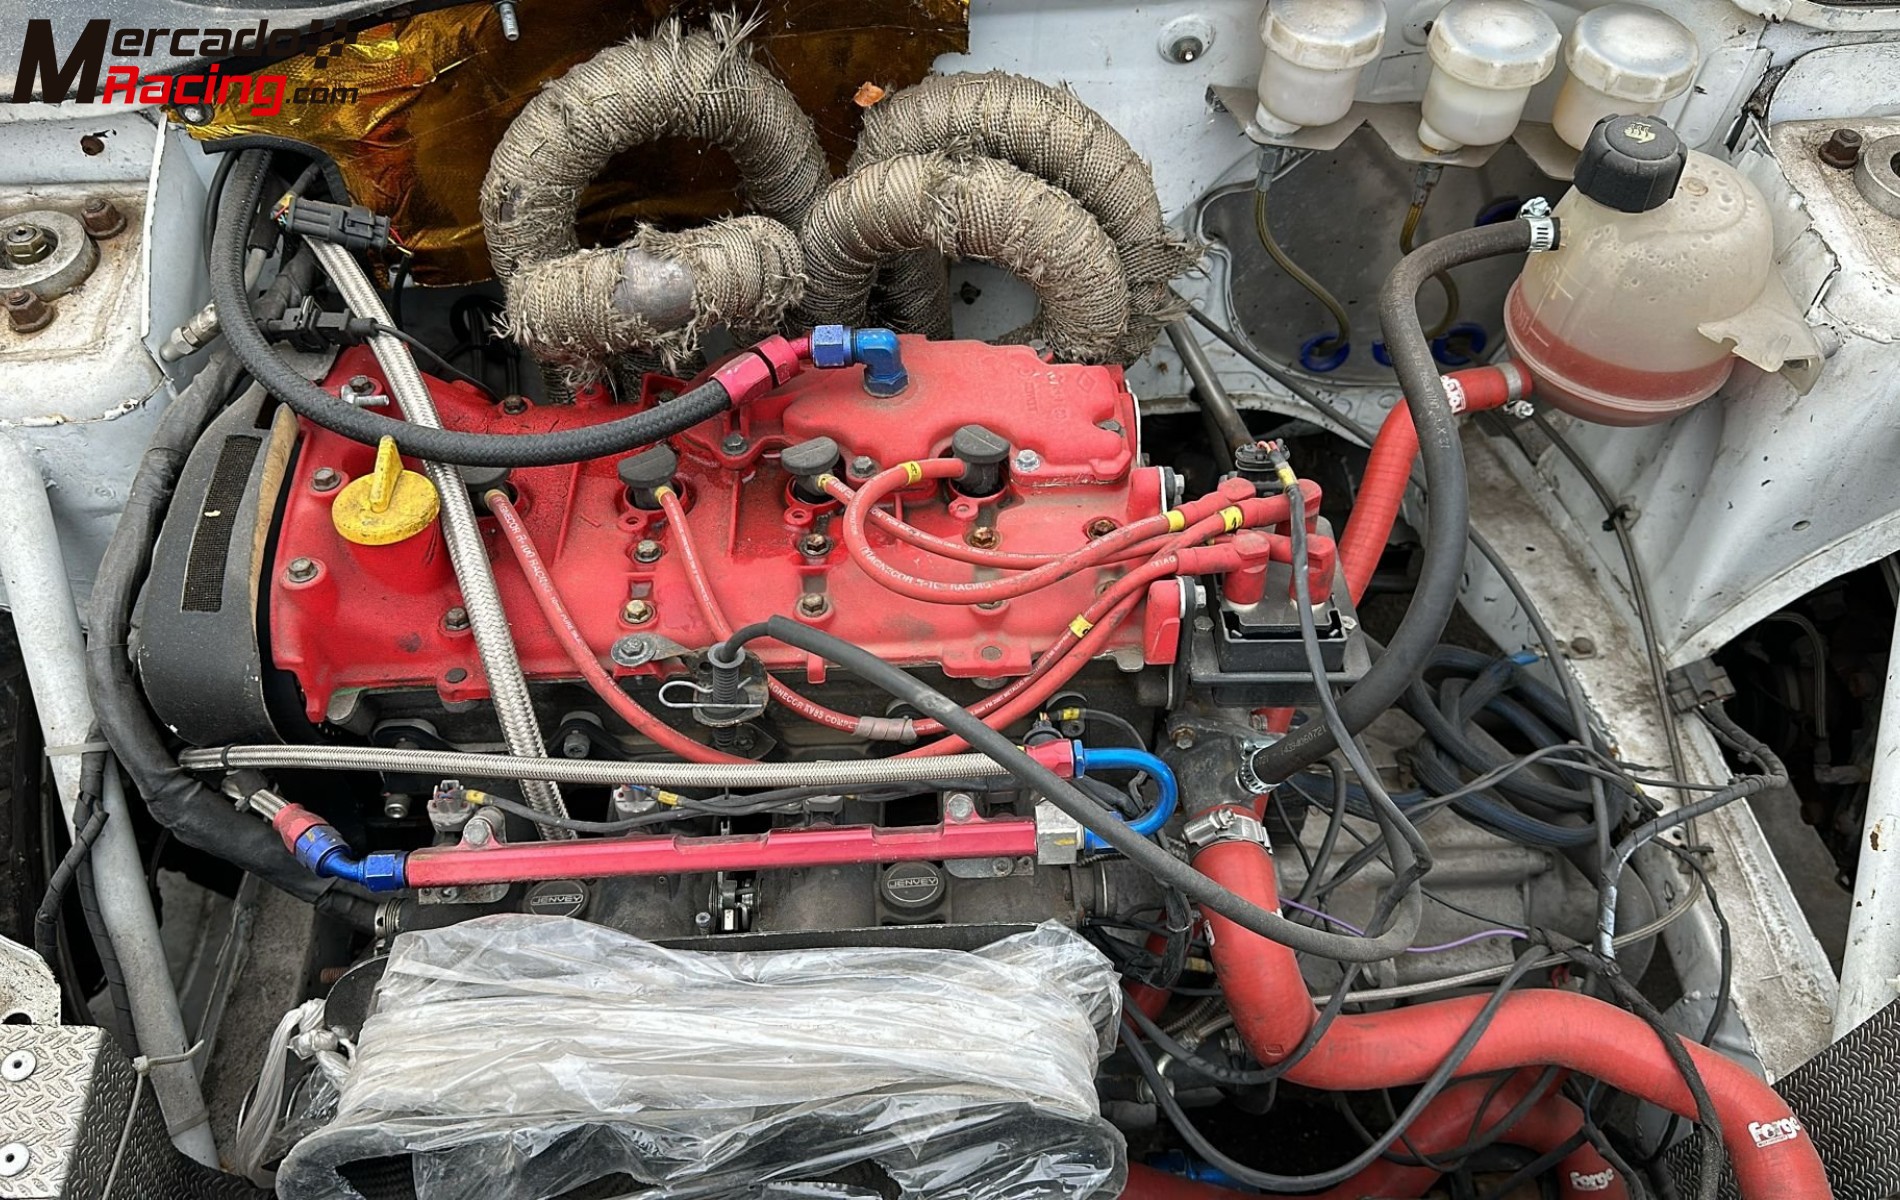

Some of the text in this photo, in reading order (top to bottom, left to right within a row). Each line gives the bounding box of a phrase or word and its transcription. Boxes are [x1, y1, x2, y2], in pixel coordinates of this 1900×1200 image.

[768, 680, 803, 709] AGNECOR
[888, 878, 938, 888] JENVEY
[531, 895, 582, 904] JENVEY
[1747, 1116, 1801, 1142] Forge
[1569, 1168, 1614, 1190] Forge
